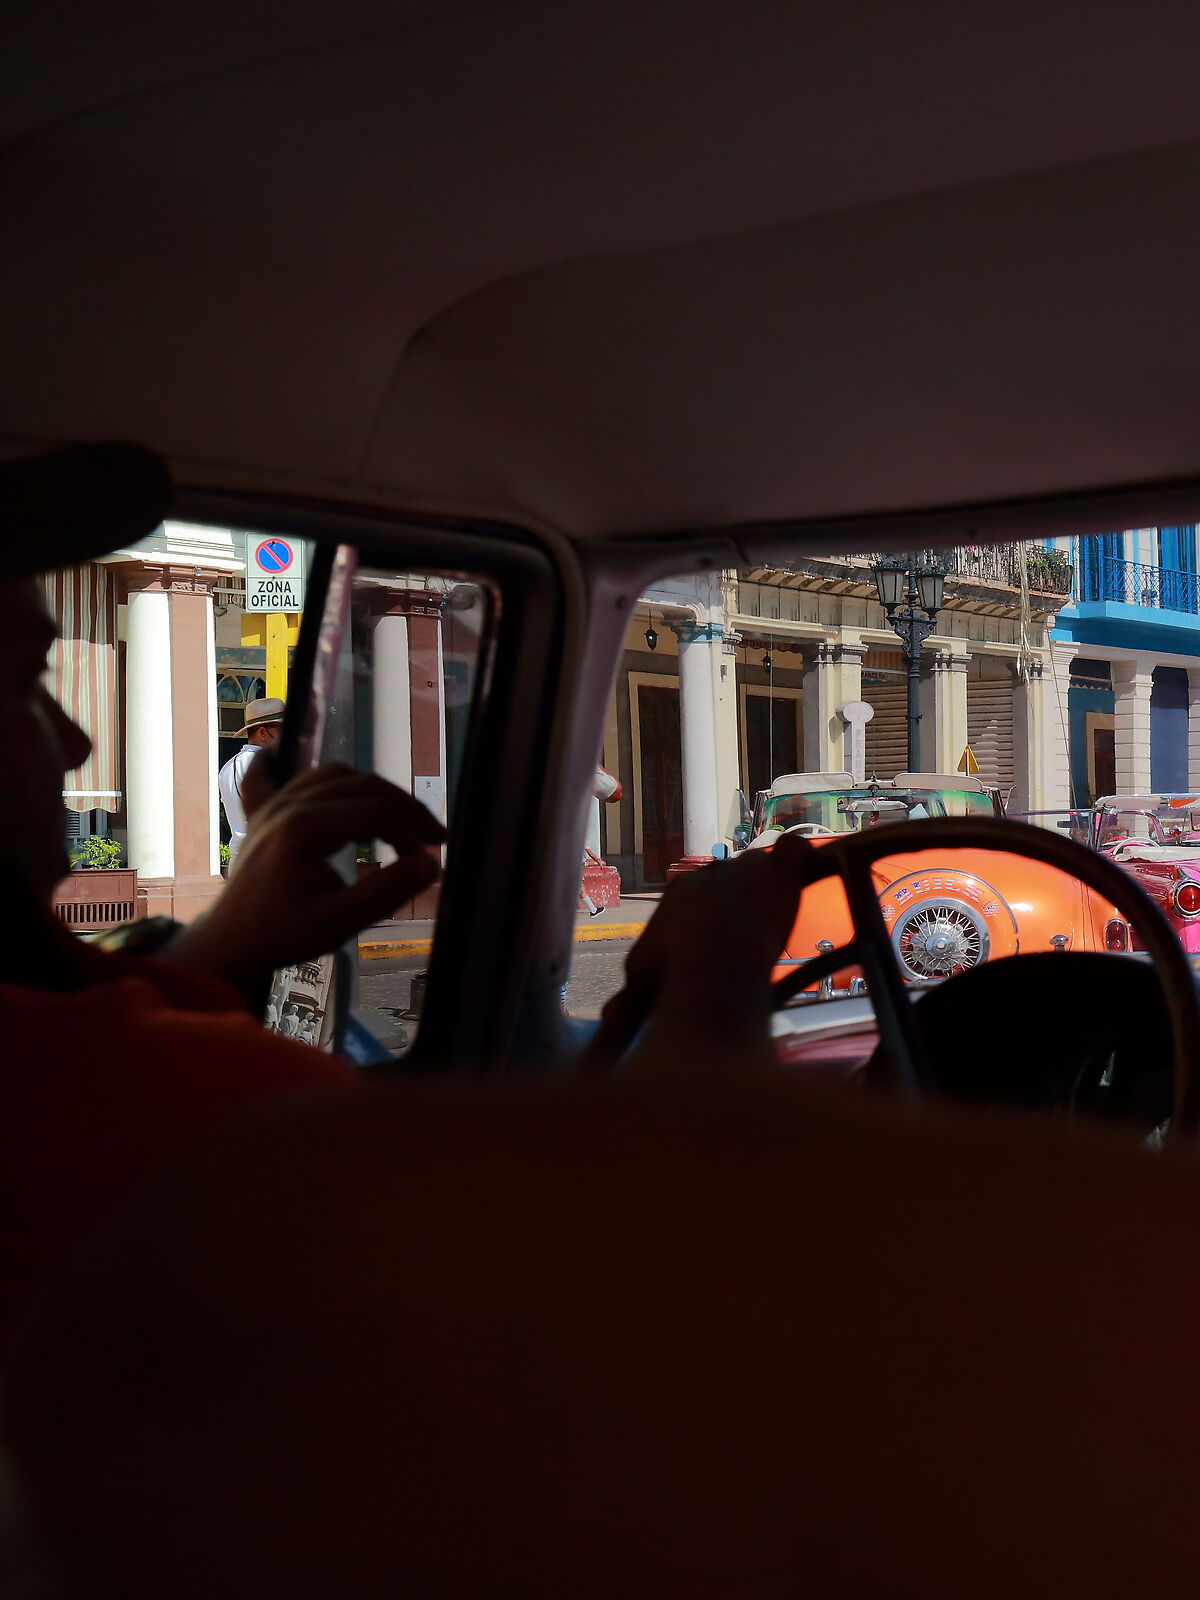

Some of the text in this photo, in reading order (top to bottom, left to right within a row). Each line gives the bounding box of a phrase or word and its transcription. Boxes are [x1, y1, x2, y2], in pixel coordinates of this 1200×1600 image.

[258, 581, 292, 593] ZONA
[251, 595, 299, 607] OFICIAL
[894, 877, 984, 906] BUICK
